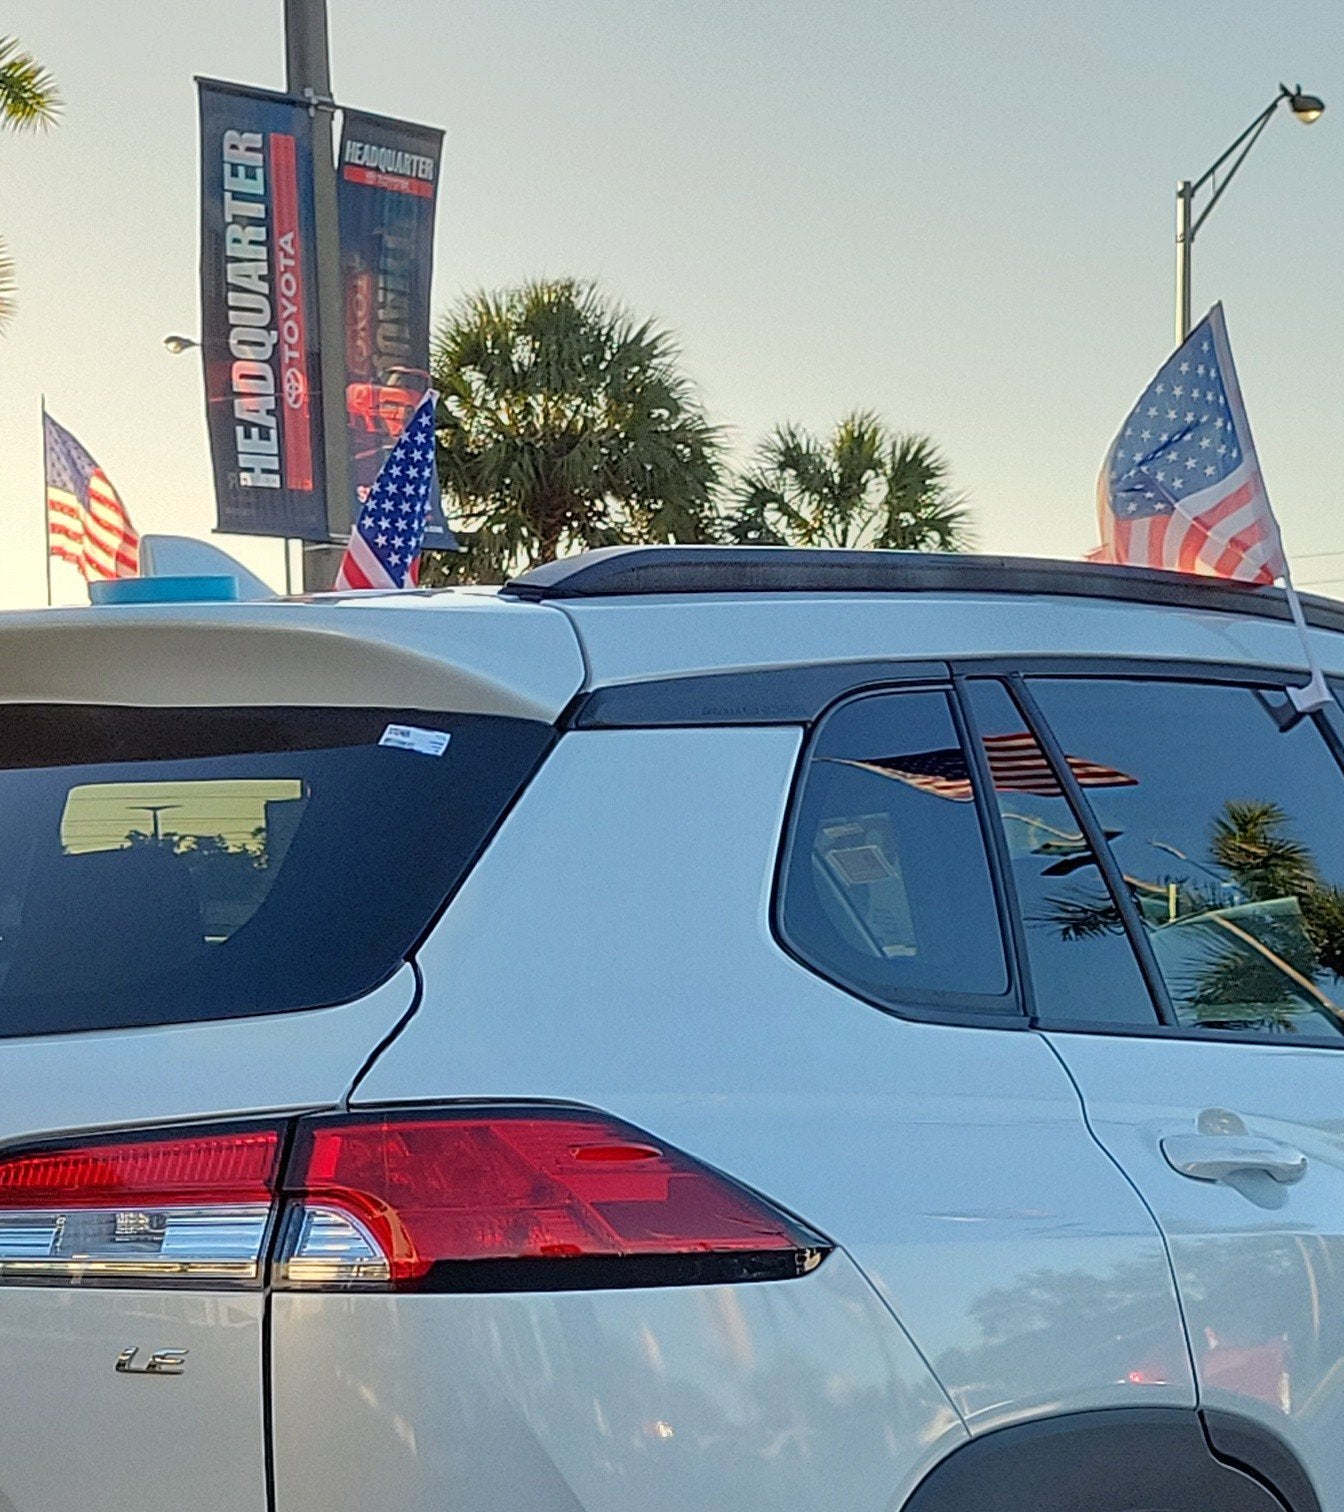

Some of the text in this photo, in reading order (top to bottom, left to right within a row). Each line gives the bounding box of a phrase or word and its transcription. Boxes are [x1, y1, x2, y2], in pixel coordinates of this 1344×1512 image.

[344, 139, 434, 181] HEADQUARTER
[223, 129, 282, 490] HEADQUARTER
[279, 230, 300, 365] TOYOTA
[115, 1345, 189, 1375] LE
